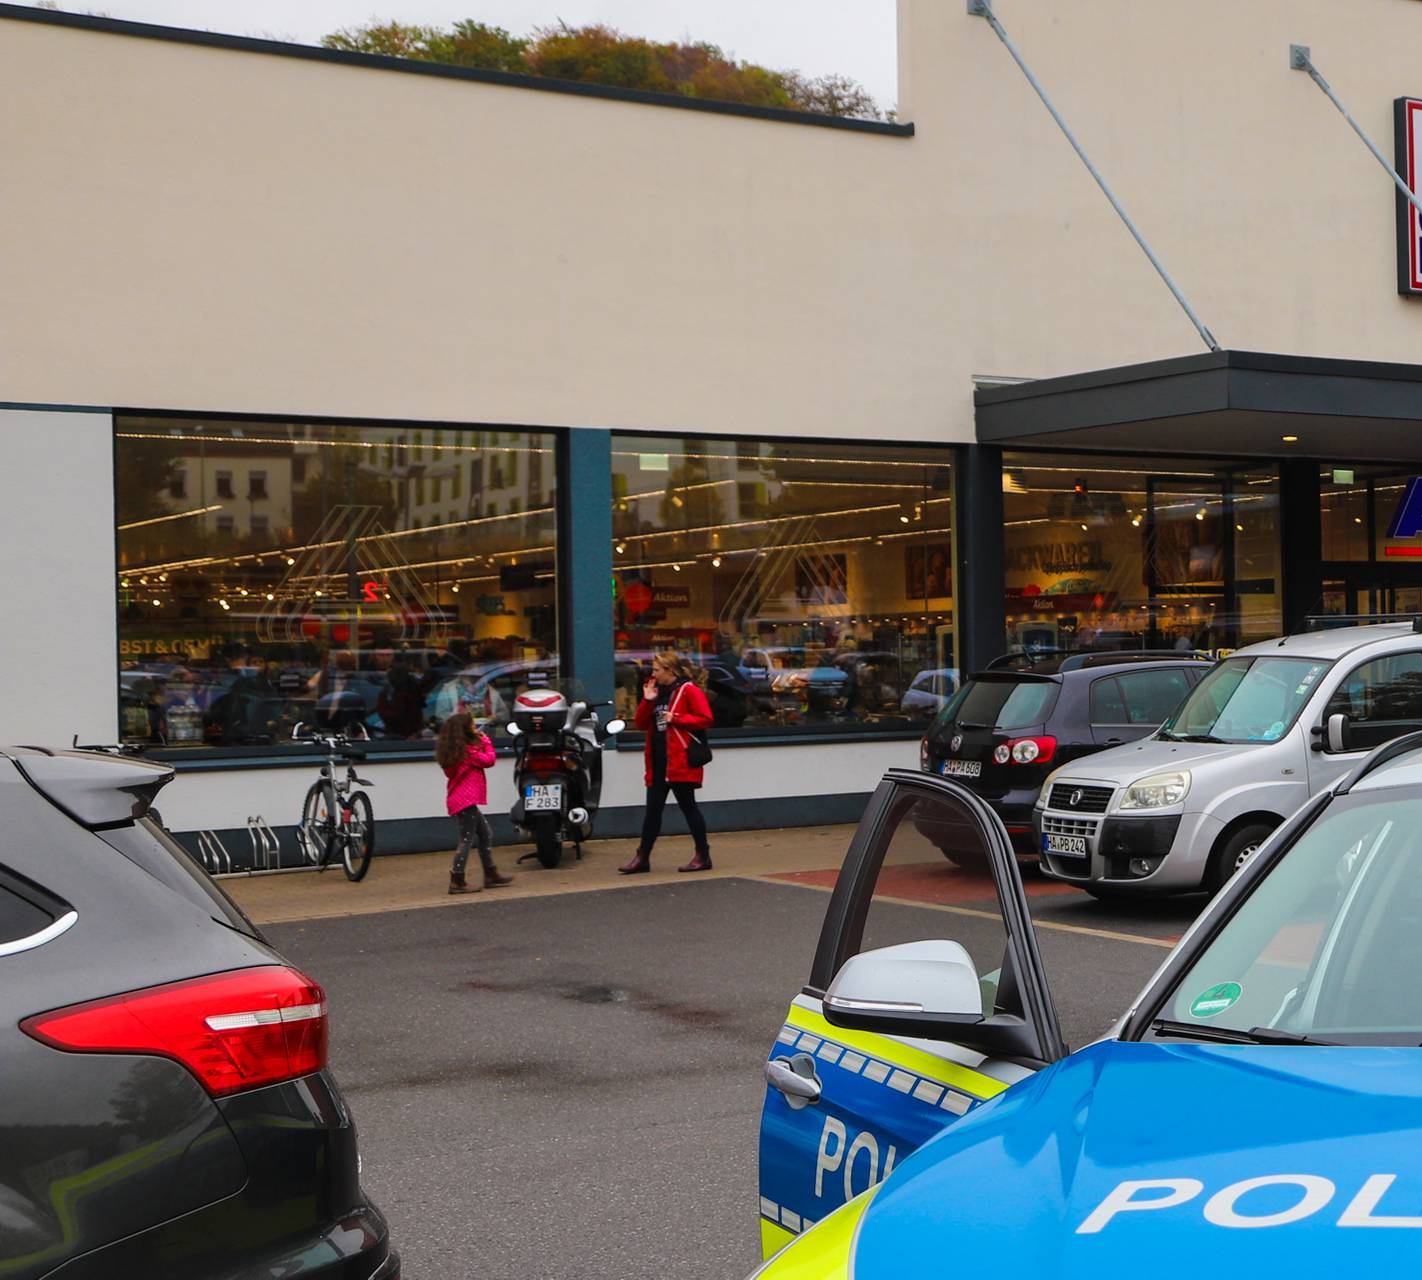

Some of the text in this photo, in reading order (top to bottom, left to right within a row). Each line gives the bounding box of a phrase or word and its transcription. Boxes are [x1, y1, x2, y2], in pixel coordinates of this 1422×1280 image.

[533, 786, 549, 797] HA
[526, 797, 559, 809] F 283
[1060, 837, 1070, 851] PB
[1071, 839, 1084, 853] 242
